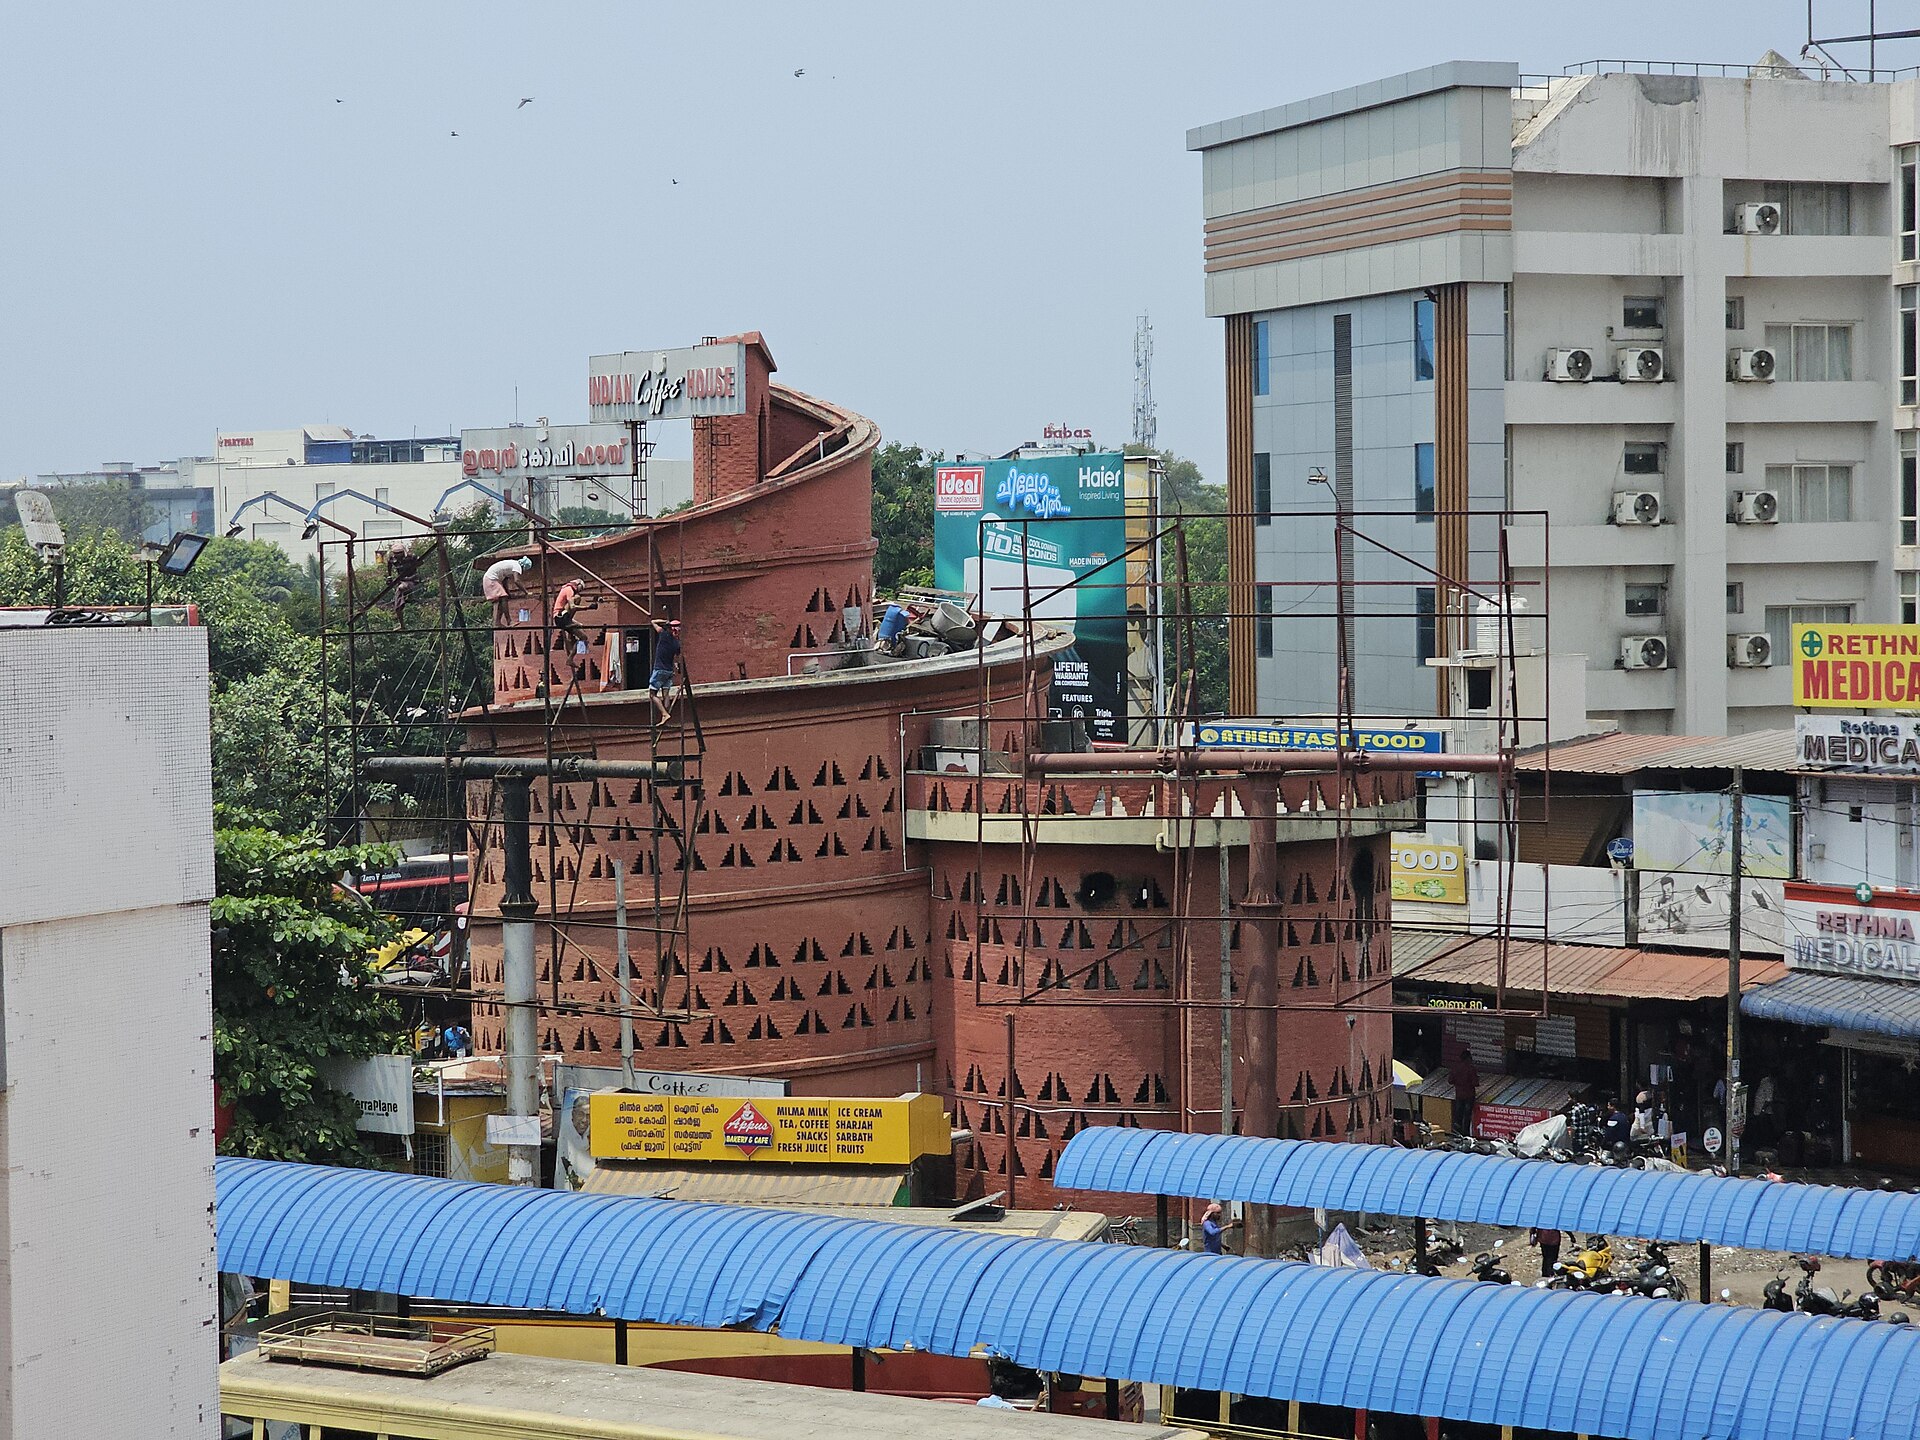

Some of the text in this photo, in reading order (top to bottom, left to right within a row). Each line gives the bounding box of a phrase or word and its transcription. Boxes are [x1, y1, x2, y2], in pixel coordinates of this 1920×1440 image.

[589, 366, 736, 415] INDIAN Coffee HOUSE
[1044, 422, 1092, 438] babas
[521, 440, 574, 467] കോഫി
[1079, 466, 1121, 488] Haier
[941, 472, 979, 494] ideal
[953, 496, 978, 504] appliances
[1079, 491, 1120, 501] Inspired Living
[986, 530, 1013, 554] 10
[1069, 557, 1085, 565] MADE
[1092, 558, 1108, 566] INDIA
[1828, 634, 1920, 655] RETHN
[1054, 661, 1089, 672] LIFETIME
[1054, 672, 1089, 680] WARRANTY
[1062, 694, 1093, 702] FEATURES
[1840, 720, 1899, 736] Rethna
[1221, 729, 1425, 749] ATHENS FAST FOOD
[1803, 735, 1920, 764] MEDICA
[362, 874, 375, 882] Zero
[1816, 911, 1915, 940] RETHNA
[619, 1102, 664, 1112] മിൽമ പാൽ
[674, 1103, 719, 1114] ഐസ് ക്രീം
[777, 1107, 828, 1116] MILMA MILK
[838, 1108, 883, 1118] ICE CREAM
[639, 1115, 667, 1125] കോഫി
[726, 1117, 770, 1132] Appus
[779, 1119, 829, 1129] TEA, COFFEE
[836, 1120, 873, 1130] SHARJAH
[726, 1135, 749, 1143] BAKERY
[754, 1136, 769, 1144] CAFE
[796, 1131, 828, 1141] SNACKS
[836, 1132, 873, 1142] SARBATH
[777, 1143, 828, 1153] FRESH JUICE
[836, 1145, 865, 1154] FRUITS
